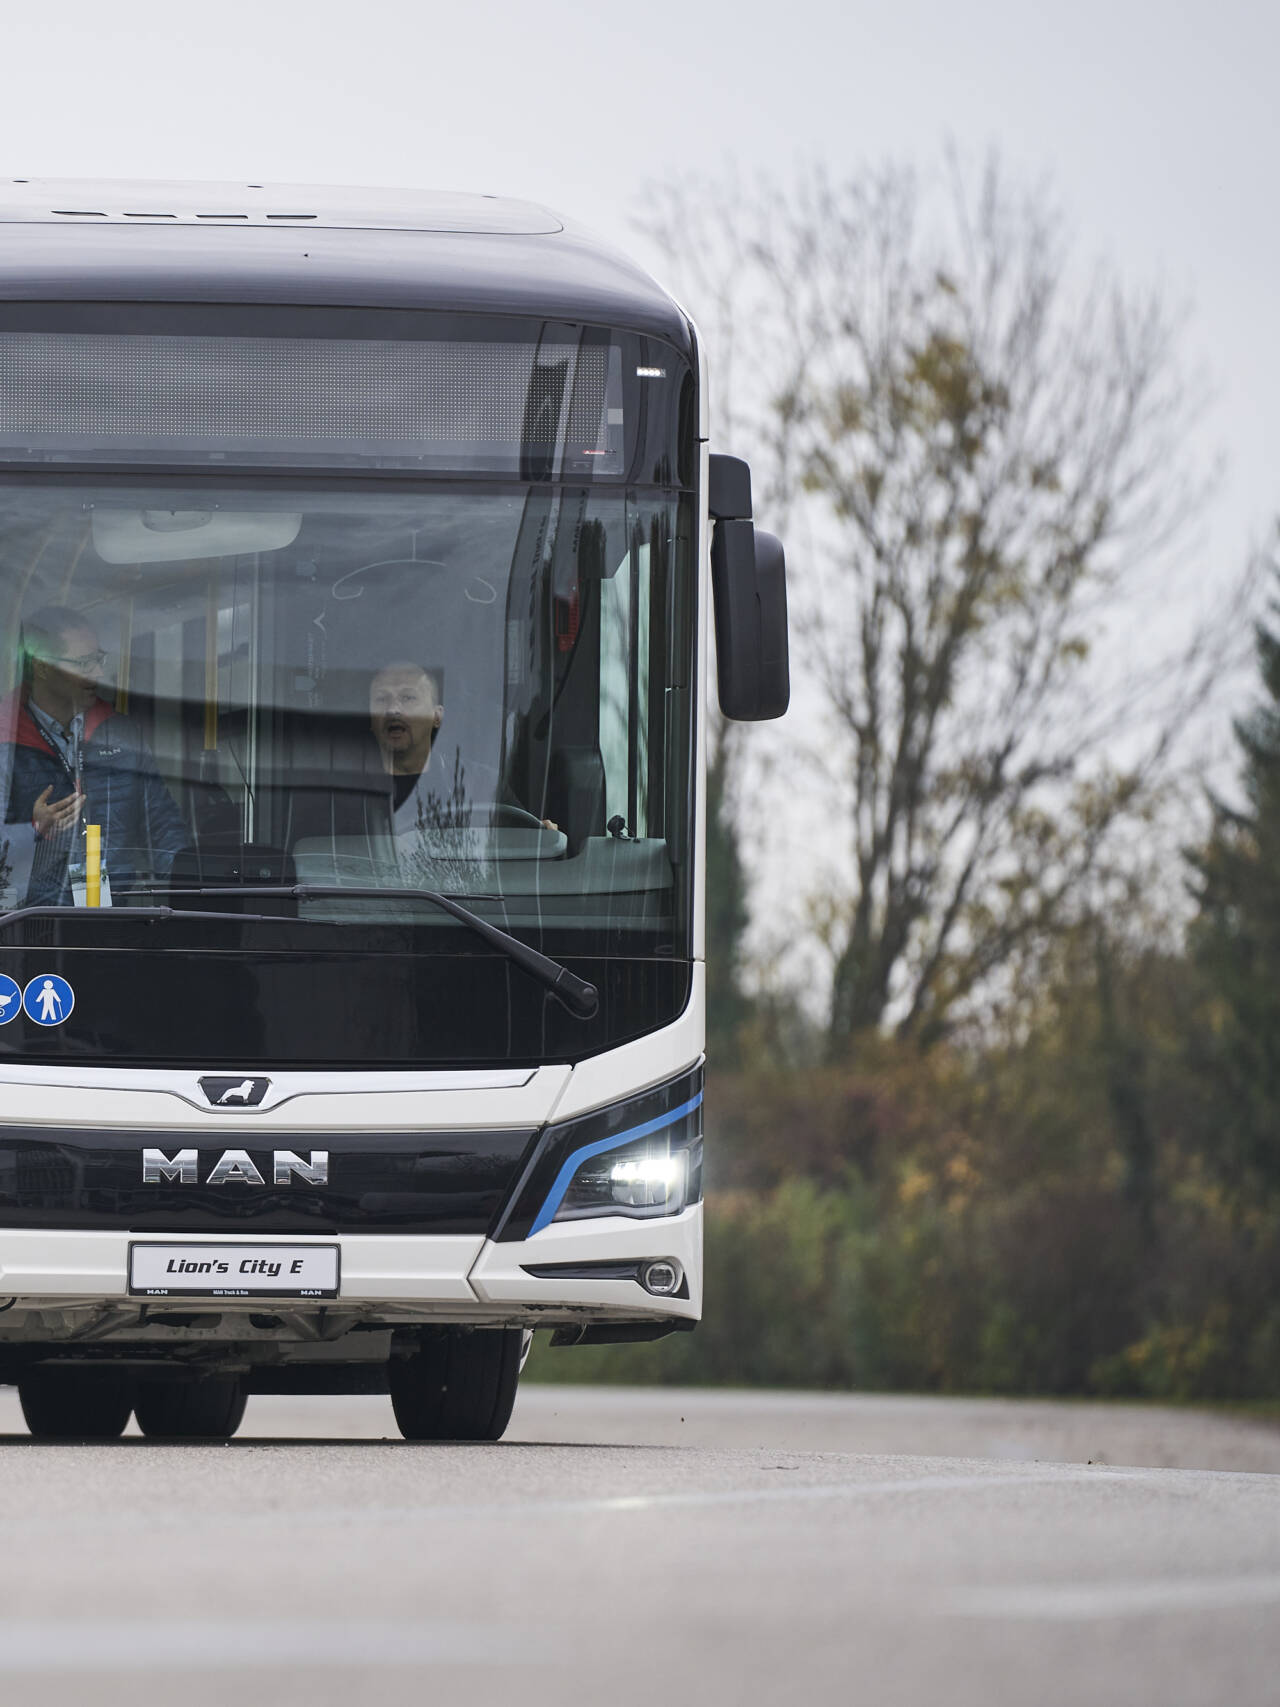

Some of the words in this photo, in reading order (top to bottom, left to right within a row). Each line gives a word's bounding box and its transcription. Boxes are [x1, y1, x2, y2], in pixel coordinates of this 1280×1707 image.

[142, 1148, 329, 1185] MAN
[166, 1259, 229, 1274] Lion's
[239, 1259, 282, 1277] City
[289, 1259, 304, 1274] E
